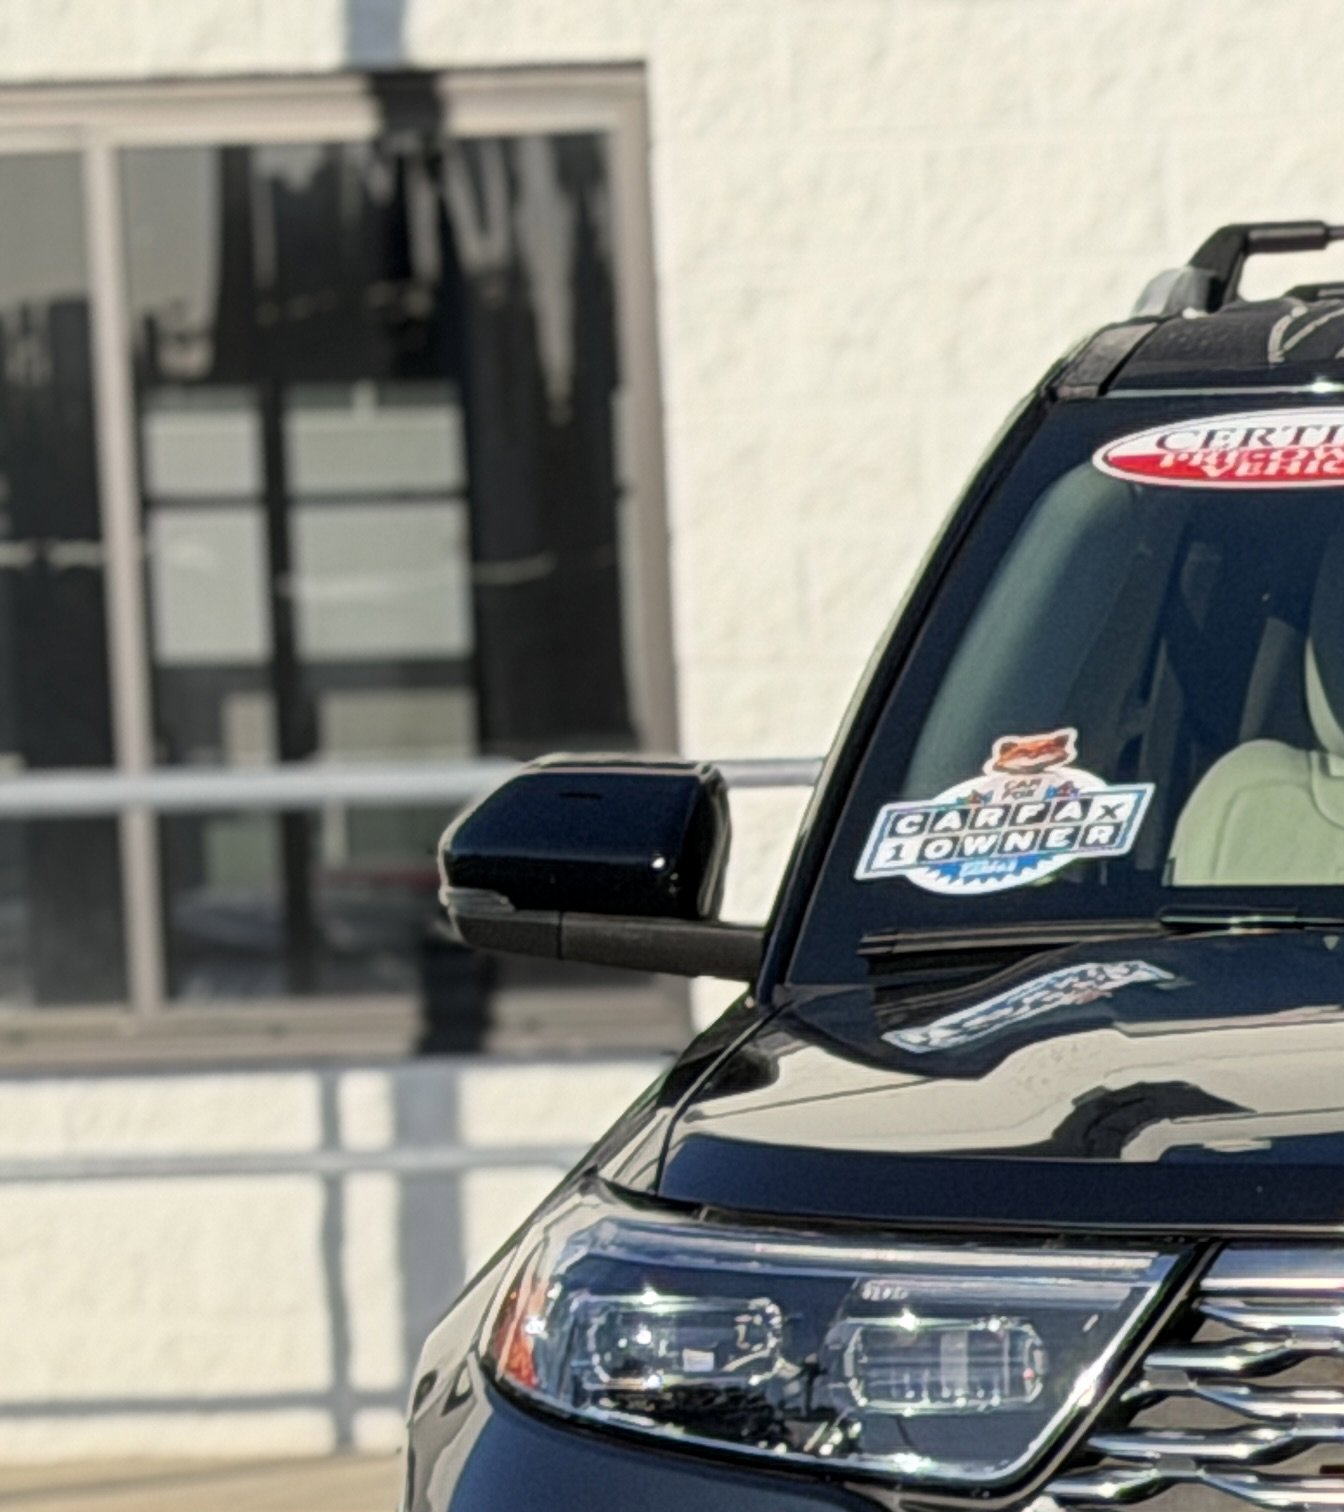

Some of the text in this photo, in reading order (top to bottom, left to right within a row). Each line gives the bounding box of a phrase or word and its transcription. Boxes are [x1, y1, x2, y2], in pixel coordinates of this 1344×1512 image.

[894, 800, 1127, 836] CARFAX
[883, 825, 1118, 863] 1 OWNER
